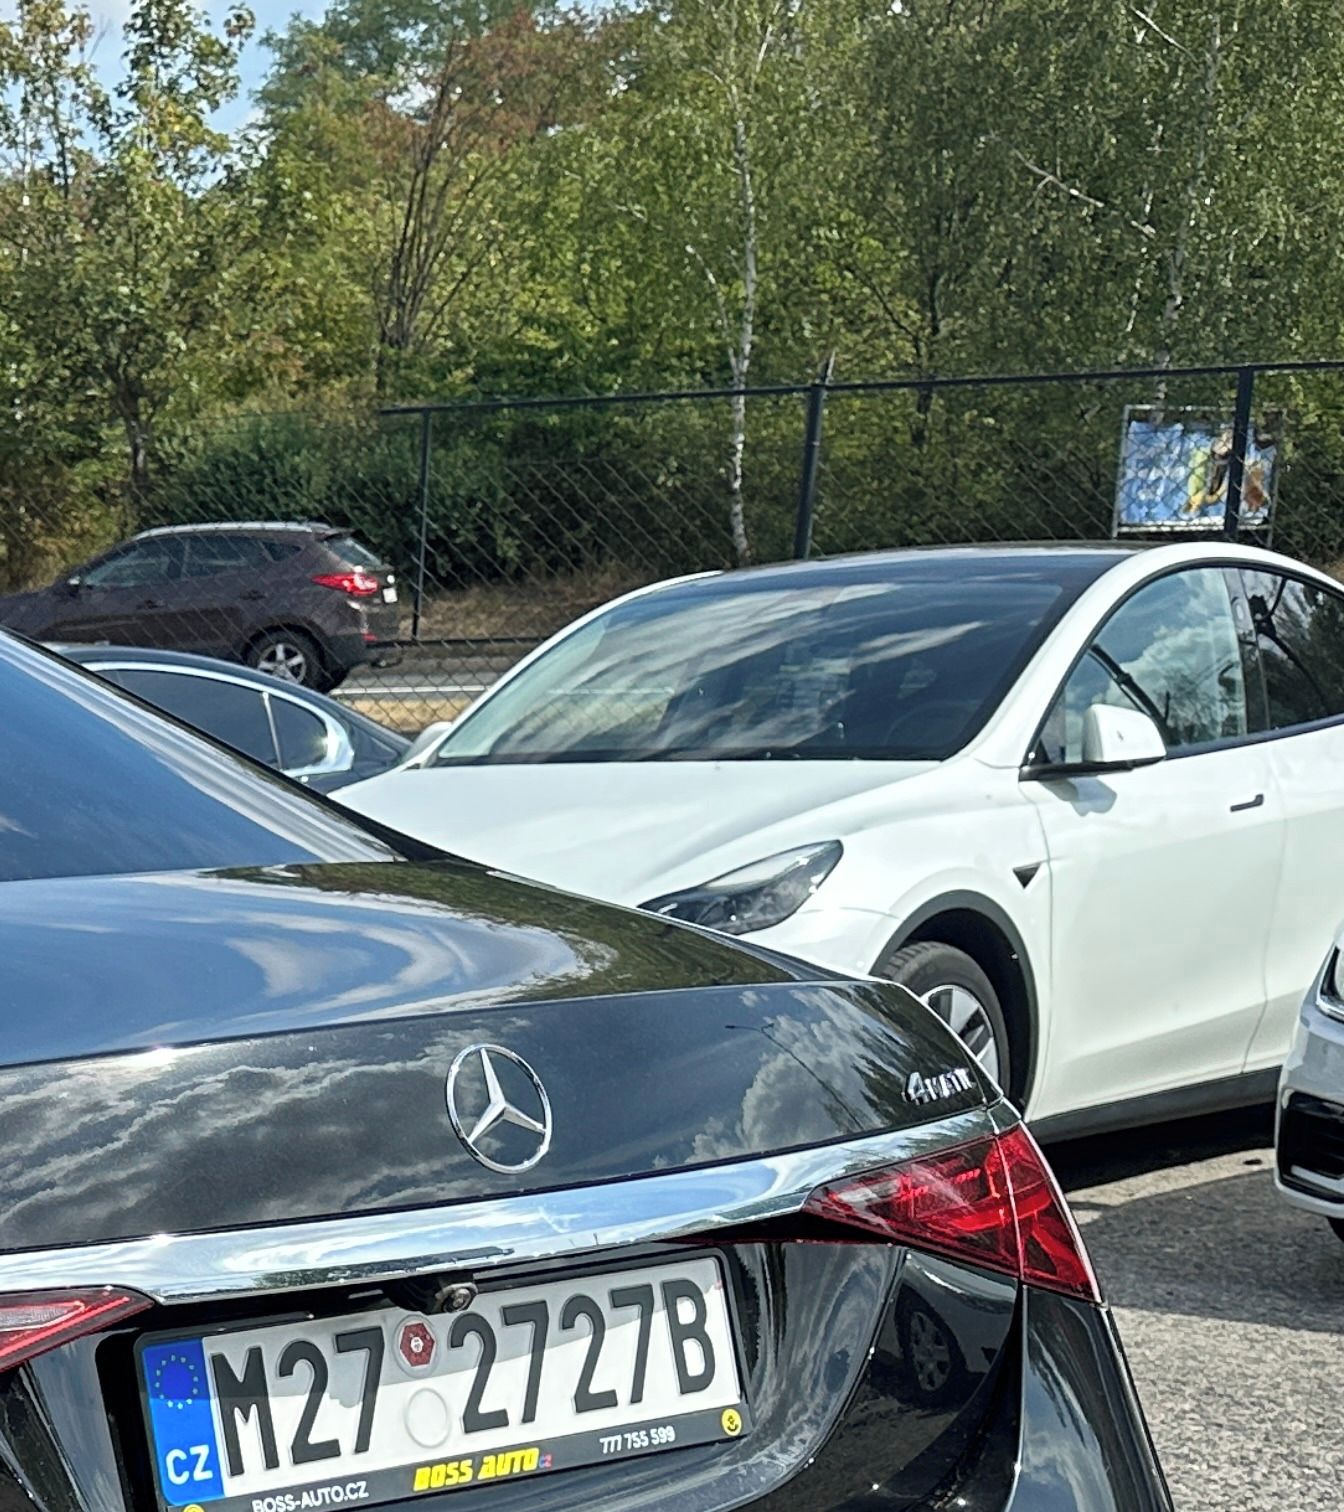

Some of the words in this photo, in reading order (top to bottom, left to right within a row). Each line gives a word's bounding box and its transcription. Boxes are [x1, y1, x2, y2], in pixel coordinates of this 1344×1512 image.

[211, 1327, 385, 1476] M27
[450, 1278, 716, 1434] 2727B
[600, 1435, 623, 1454] 777
[625, 1431, 649, 1449] 755
[650, 1425, 675, 1446] 599
[166, 1445, 213, 1485] CZ
[413, 1459, 473, 1492] BOSS
